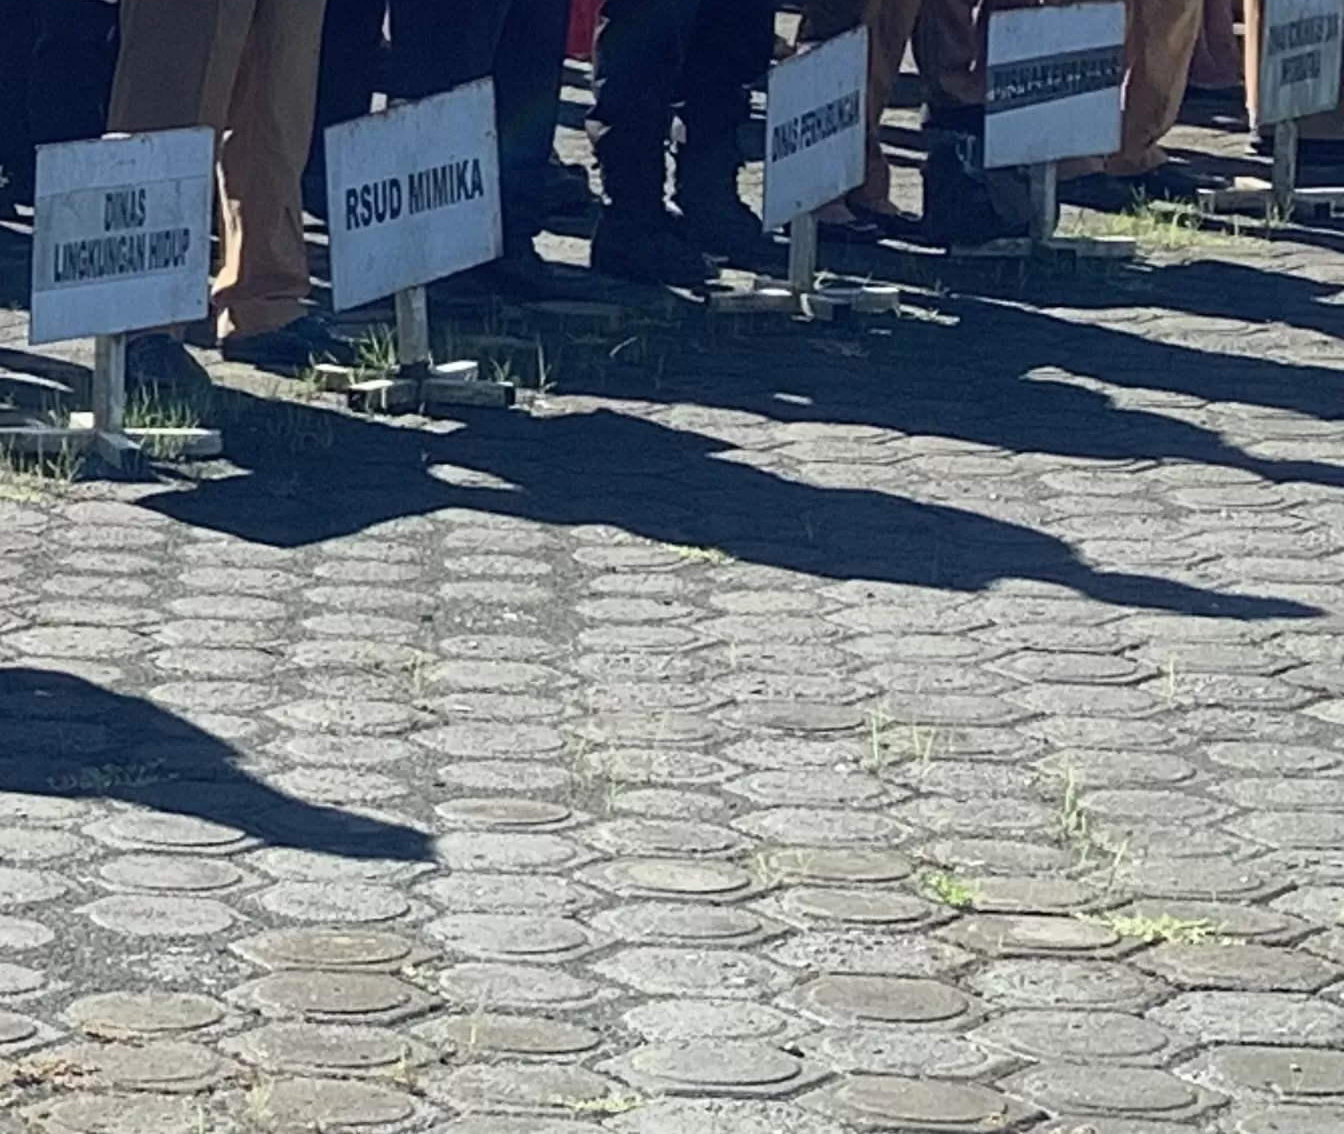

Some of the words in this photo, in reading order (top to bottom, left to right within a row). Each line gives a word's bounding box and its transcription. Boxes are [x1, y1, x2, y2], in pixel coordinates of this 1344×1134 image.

[103, 188, 147, 232] DINAS
[345, 177, 403, 231] RSUD
[407, 158, 484, 215] MIMIKA
[53, 232, 147, 283] LINGKUNGAN
[148, 227, 191, 271] HIDUP
